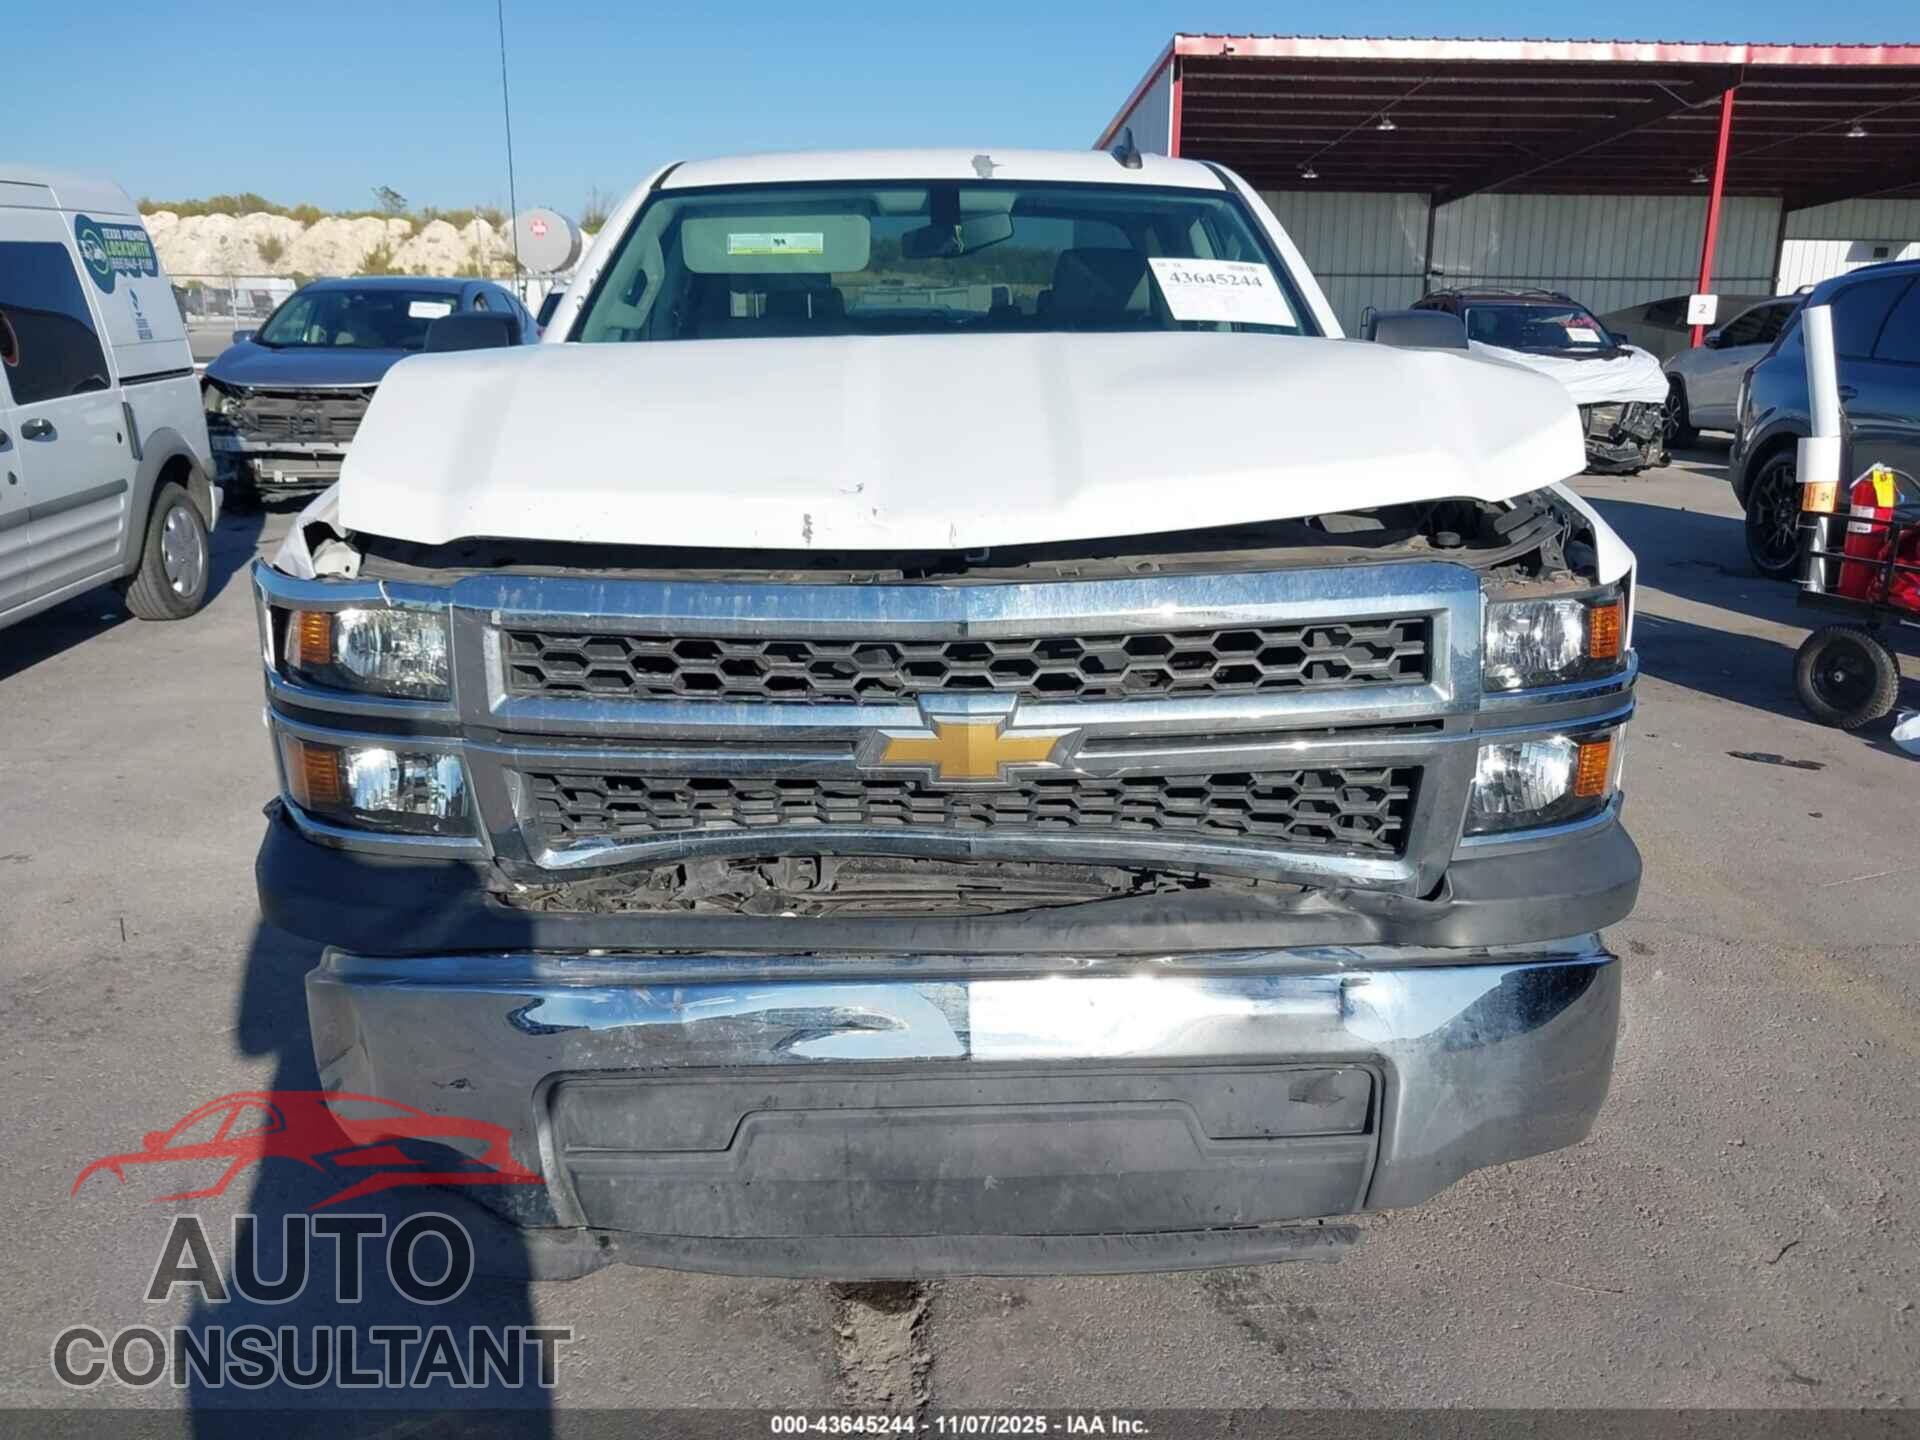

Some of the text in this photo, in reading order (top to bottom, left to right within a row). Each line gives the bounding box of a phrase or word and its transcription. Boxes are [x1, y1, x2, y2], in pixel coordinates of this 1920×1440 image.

[104, 239, 152, 257] LOCKSMITH
[1169, 271, 1264, 288] 43645244
[1697, 303, 1707, 314] 2
